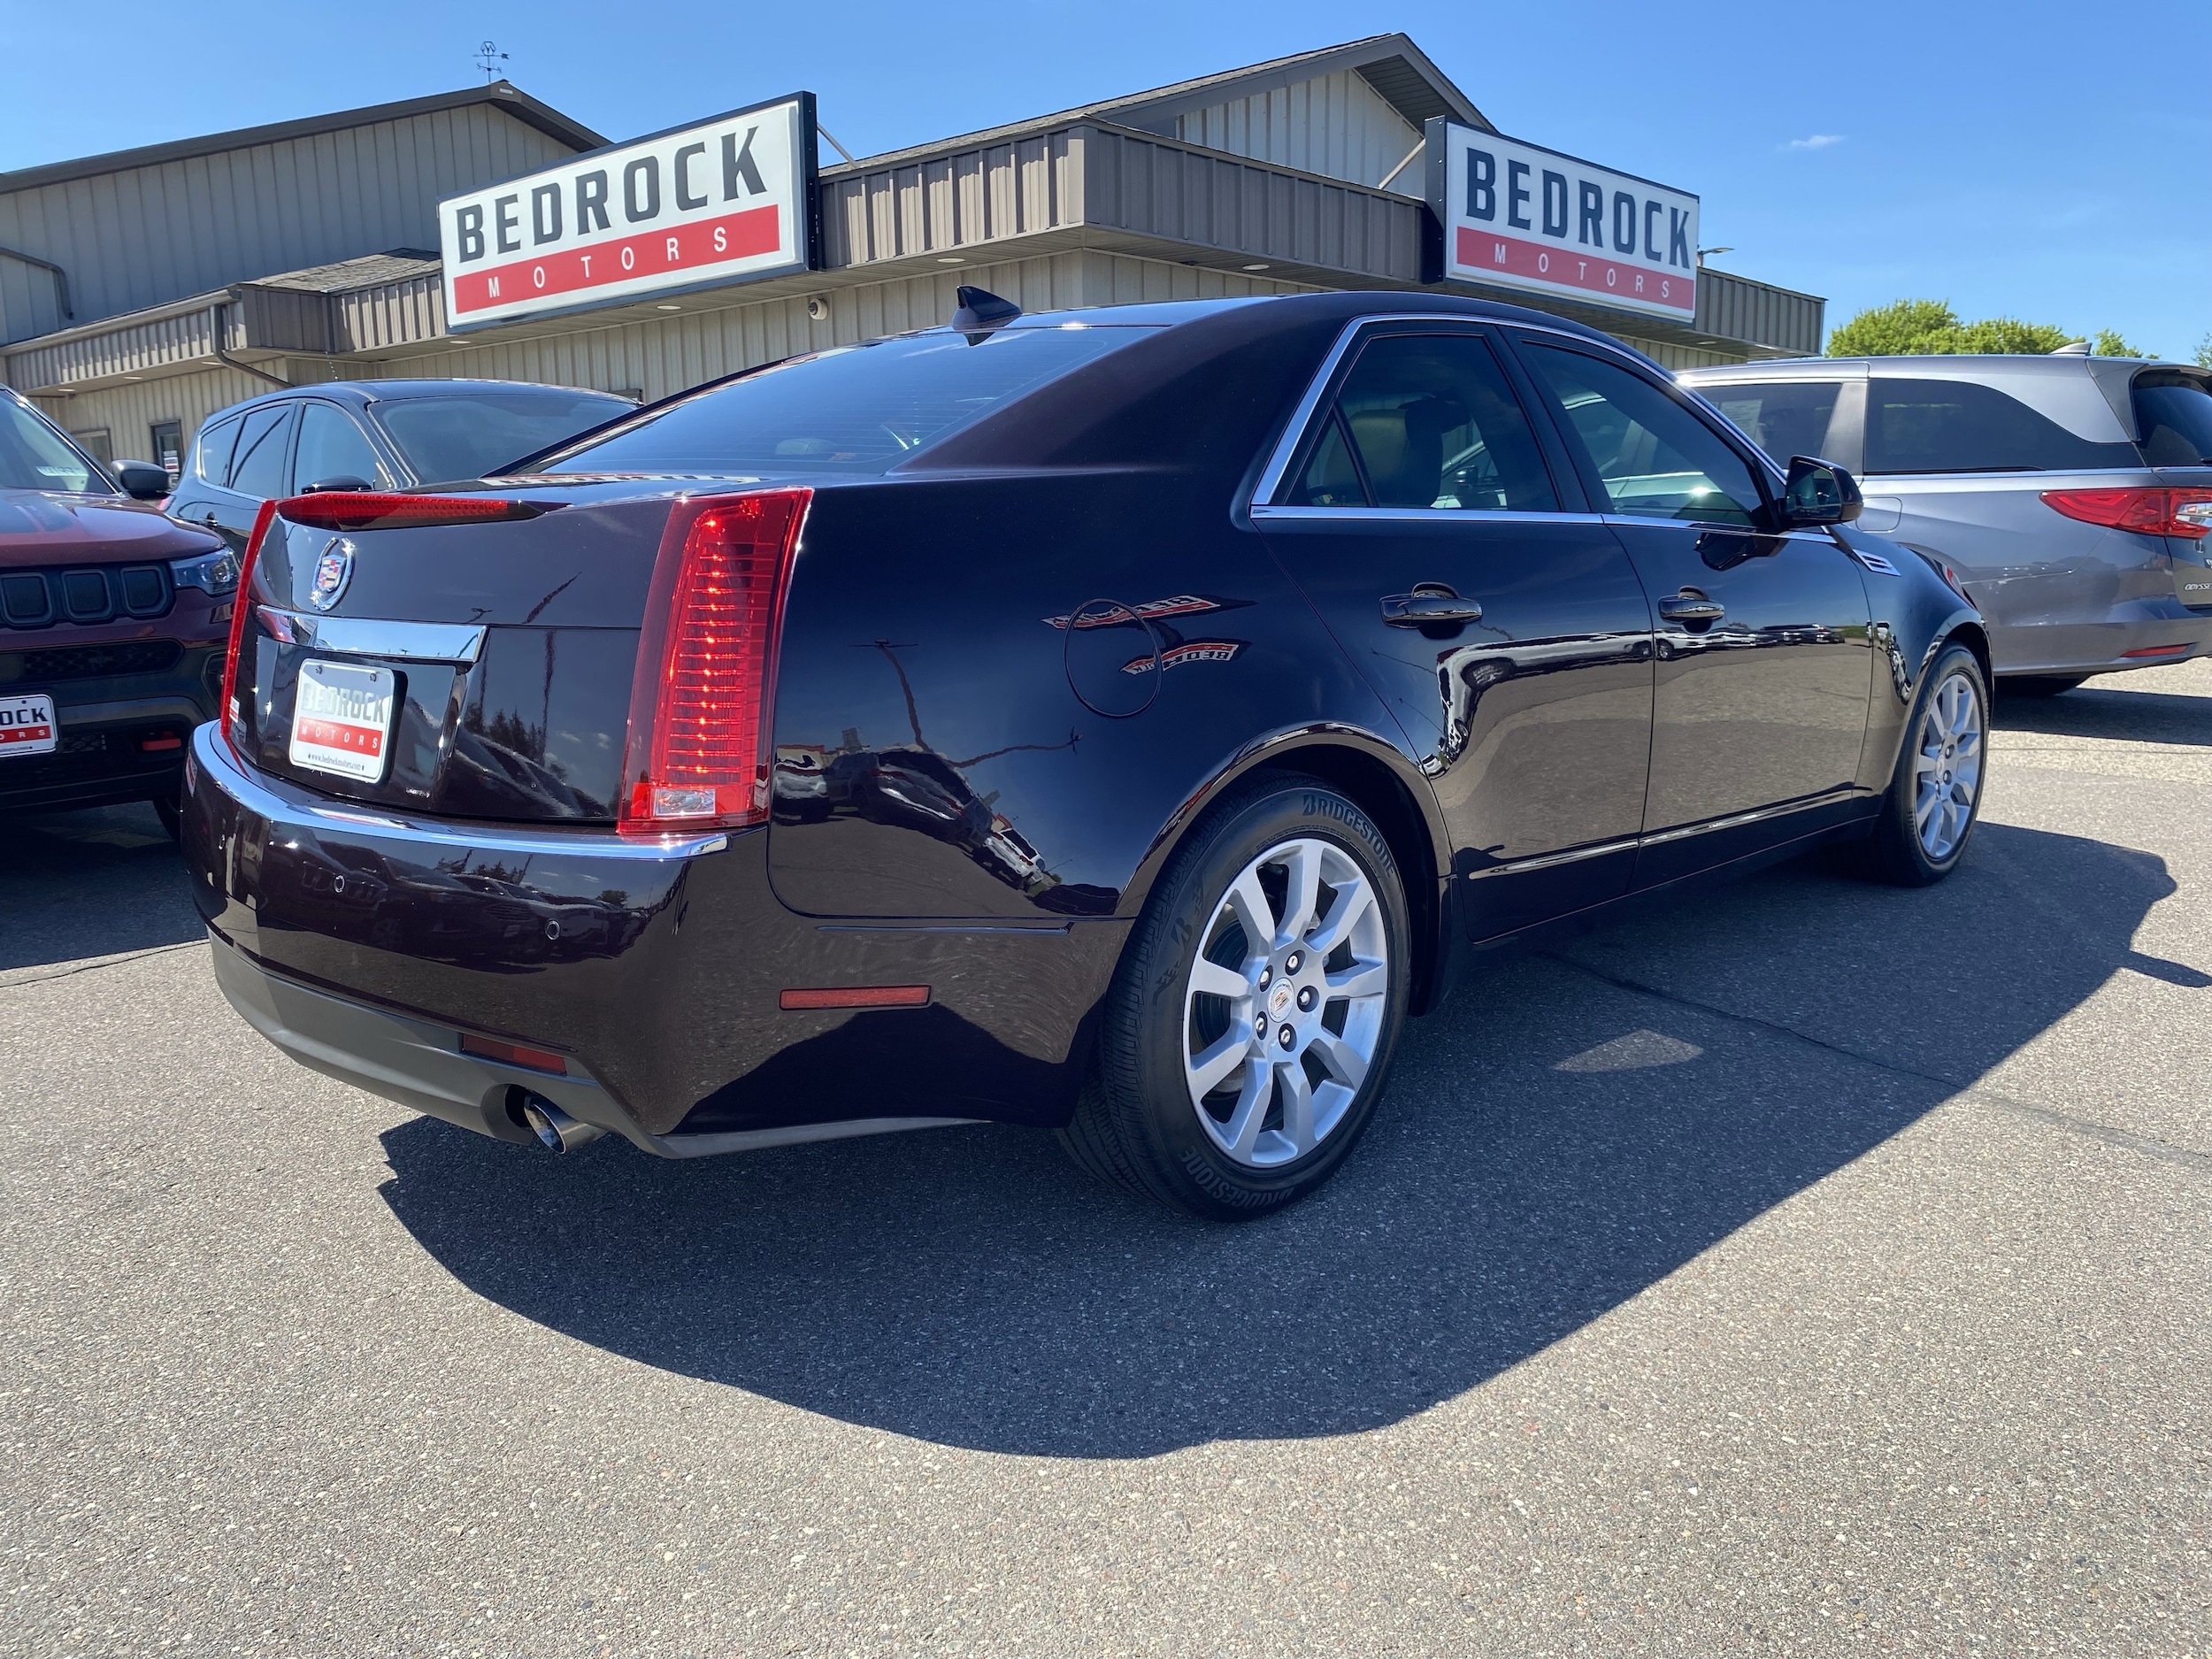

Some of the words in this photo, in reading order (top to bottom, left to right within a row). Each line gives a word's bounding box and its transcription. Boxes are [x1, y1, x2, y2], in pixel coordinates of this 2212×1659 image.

[456, 126, 767, 263] BEDROCK
[1466, 148, 1690, 269] BEDROCK
[488, 227, 727, 298] MOTORS
[1494, 243, 1670, 299] MOTORS
[301, 725, 379, 749] MOTORS
[302, 682, 384, 723] BEDROCK
[1302, 794, 1394, 878] BRIDGESTONE
